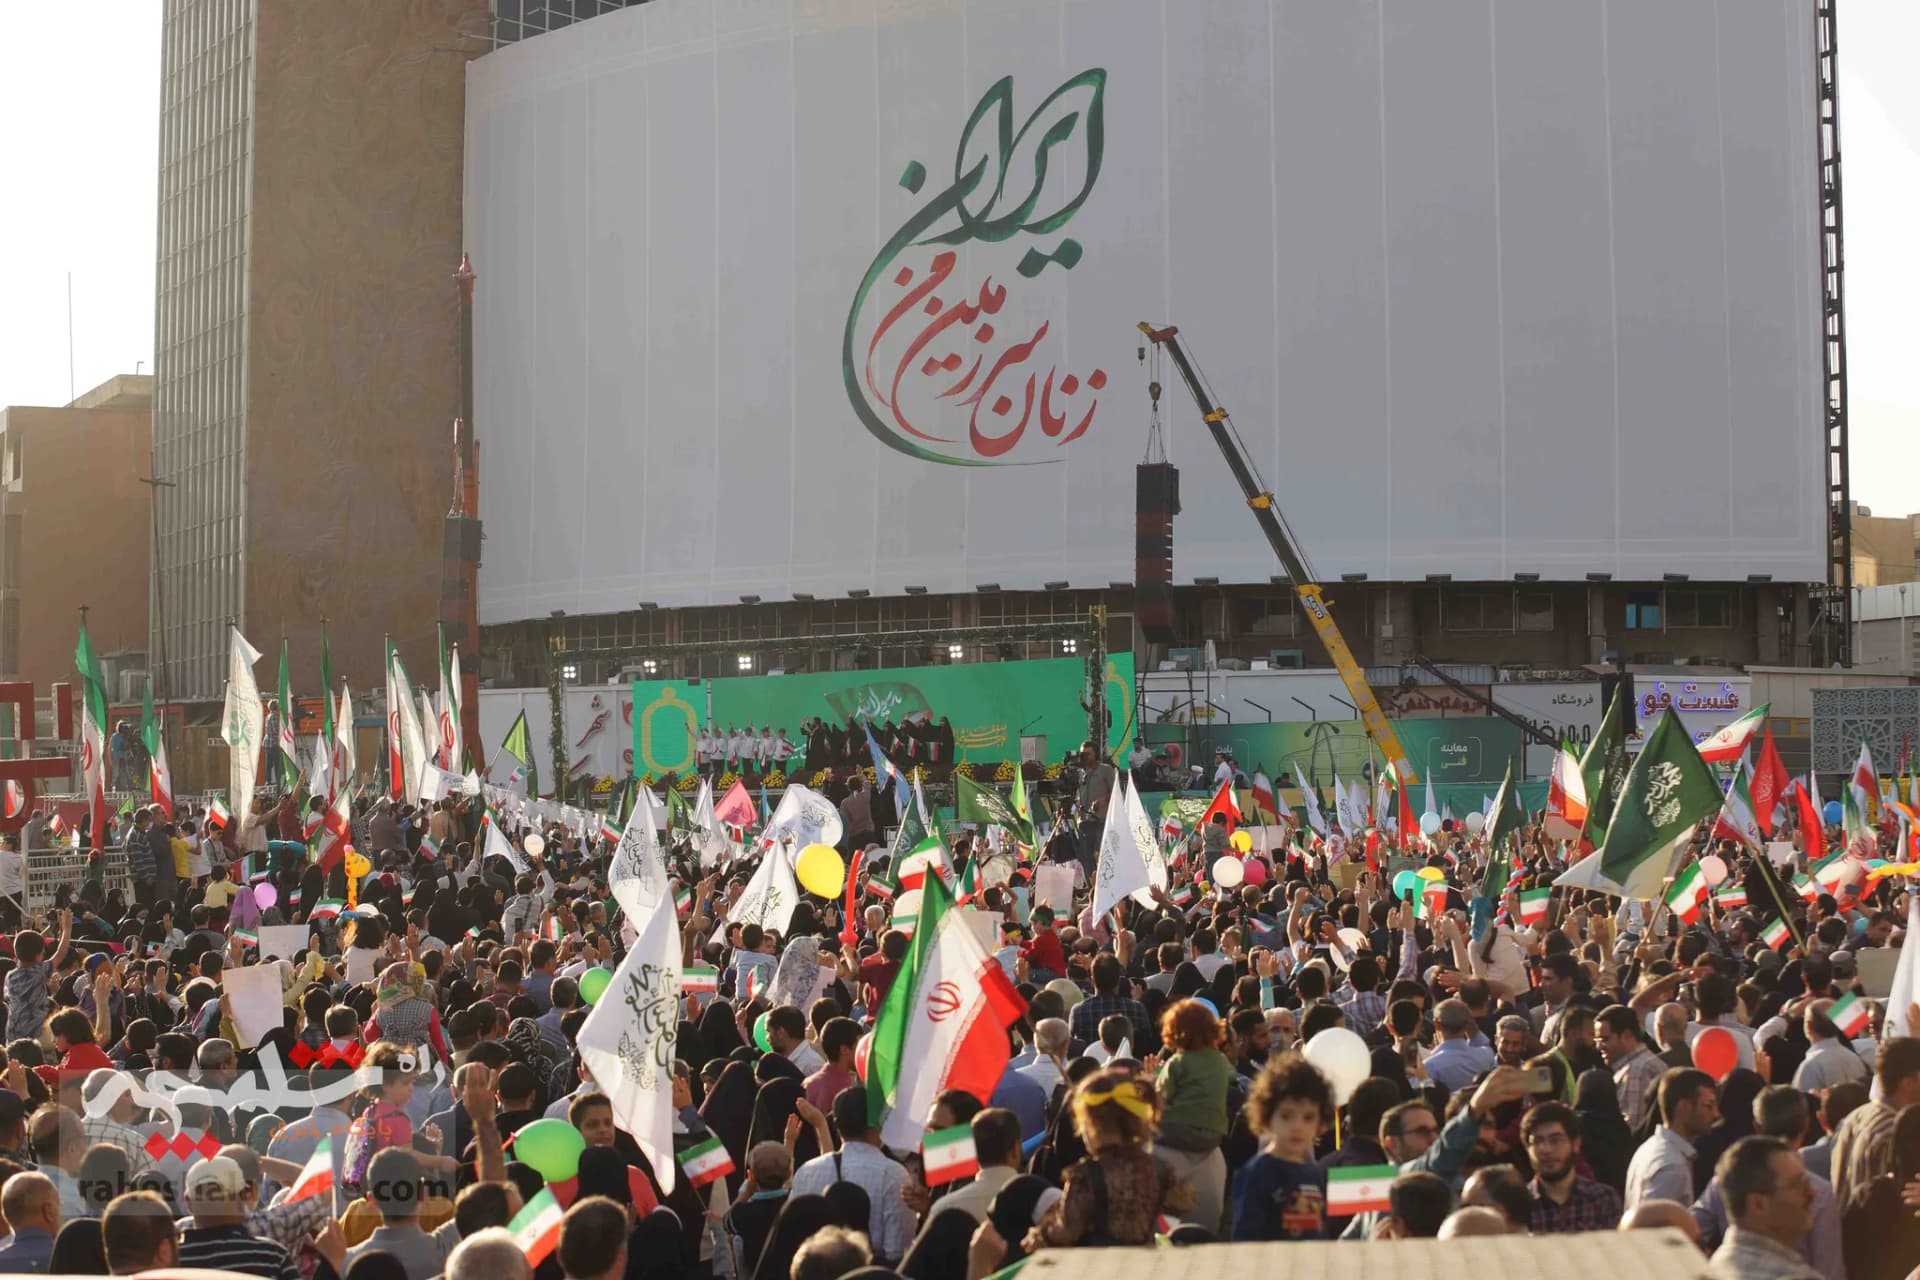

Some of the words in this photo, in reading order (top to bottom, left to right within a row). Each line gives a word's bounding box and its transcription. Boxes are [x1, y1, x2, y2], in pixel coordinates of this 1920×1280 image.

[843, 67, 1107, 467] ایران
[866, 251, 956, 408] من
[892, 275, 1049, 442] سرزمین
[970, 364, 1107, 457] زنان
[1552, 693, 1594, 707] فروشگاه
[1634, 681, 1672, 717] فو
[1674, 681, 1740, 712] فست
[1440, 743, 1468, 755] معاینه
[1440, 755, 1467, 769] فنی
